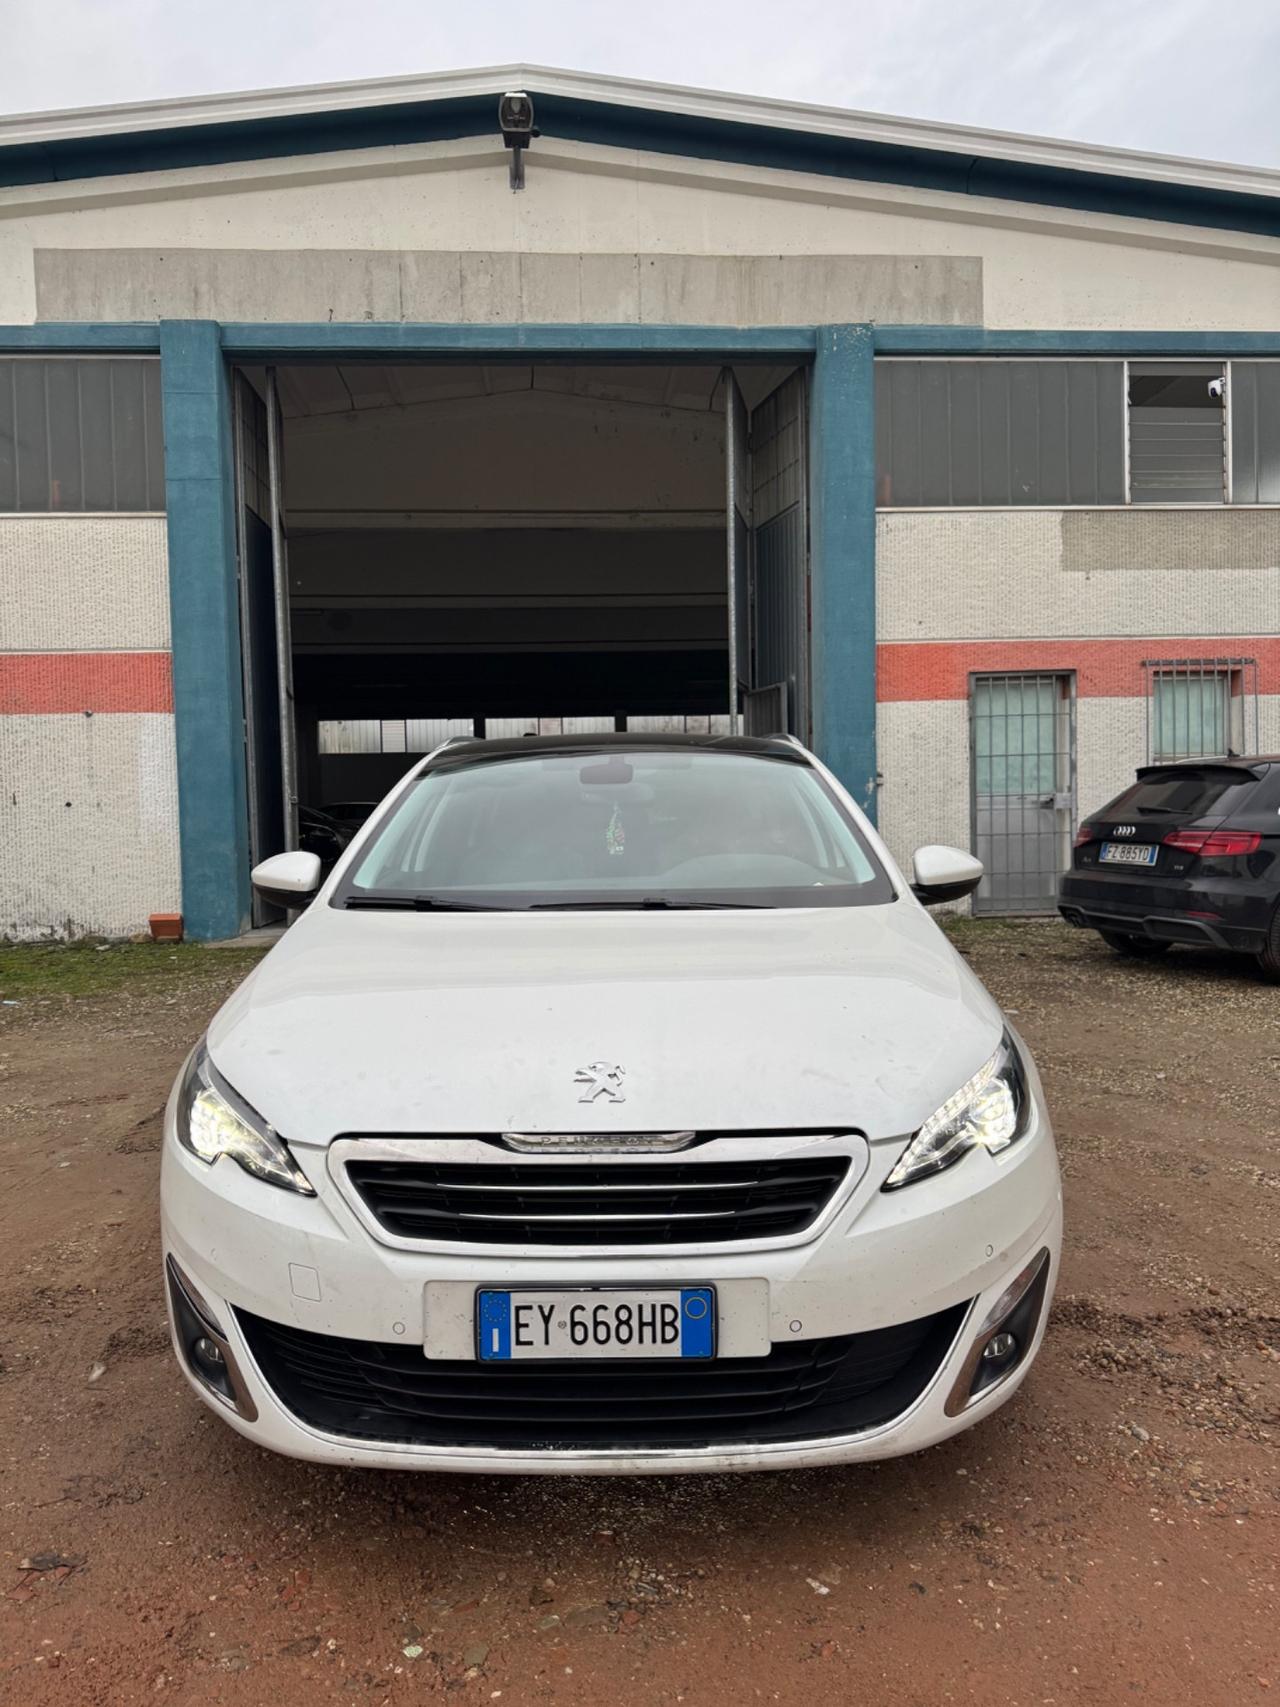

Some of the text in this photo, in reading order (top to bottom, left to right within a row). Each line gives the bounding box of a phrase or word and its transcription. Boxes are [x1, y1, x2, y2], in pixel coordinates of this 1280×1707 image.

[1107, 845, 1118, 859] FZ
[514, 1303, 680, 1346] EY 668HB
